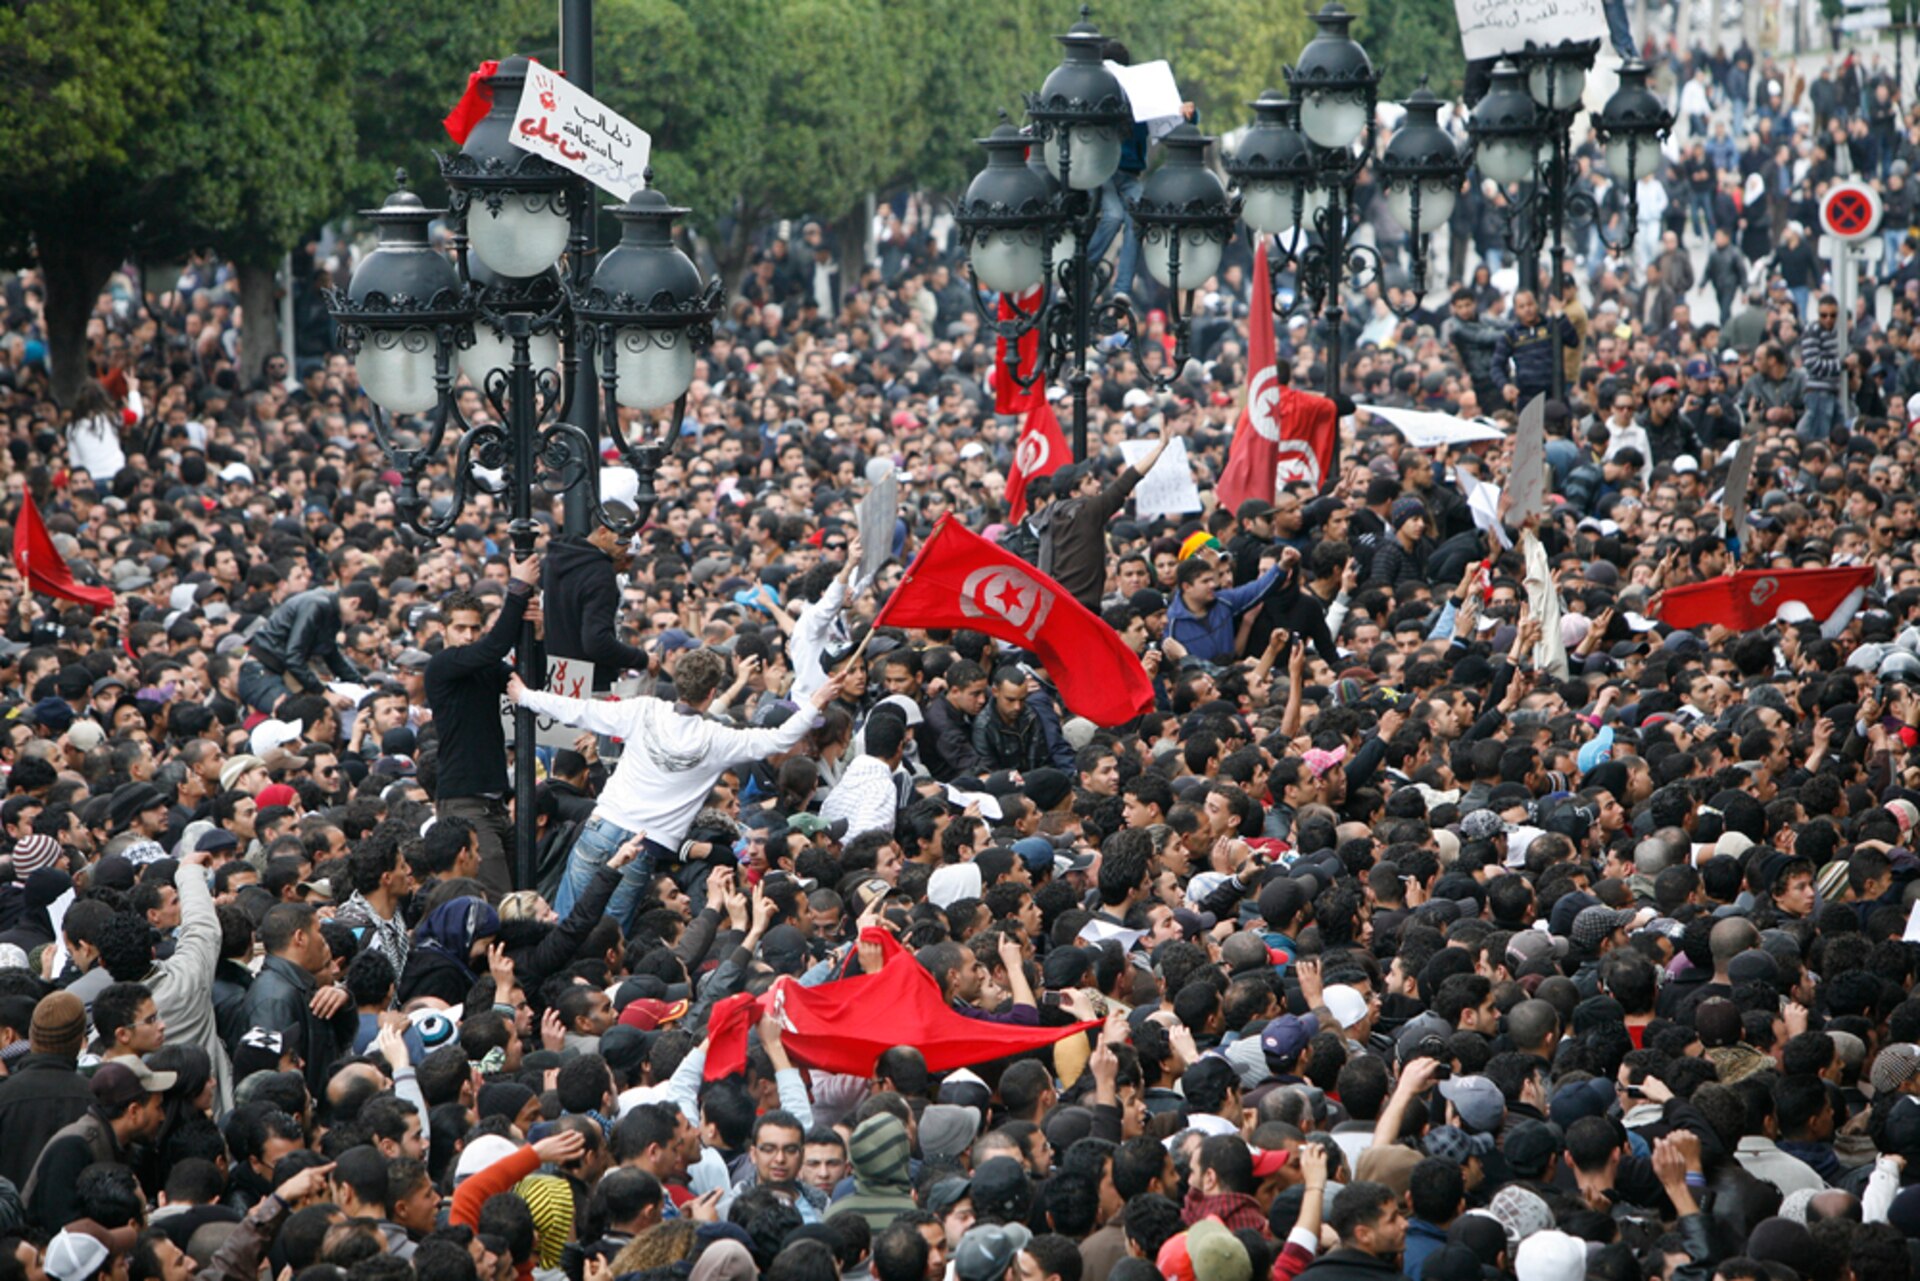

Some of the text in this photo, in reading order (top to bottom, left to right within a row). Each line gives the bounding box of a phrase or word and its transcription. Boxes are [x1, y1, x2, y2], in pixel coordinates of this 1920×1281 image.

[519, 116, 588, 163] بن علي
[562, 120, 624, 168] باستقالة
[573, 104, 632, 149] نطالب
